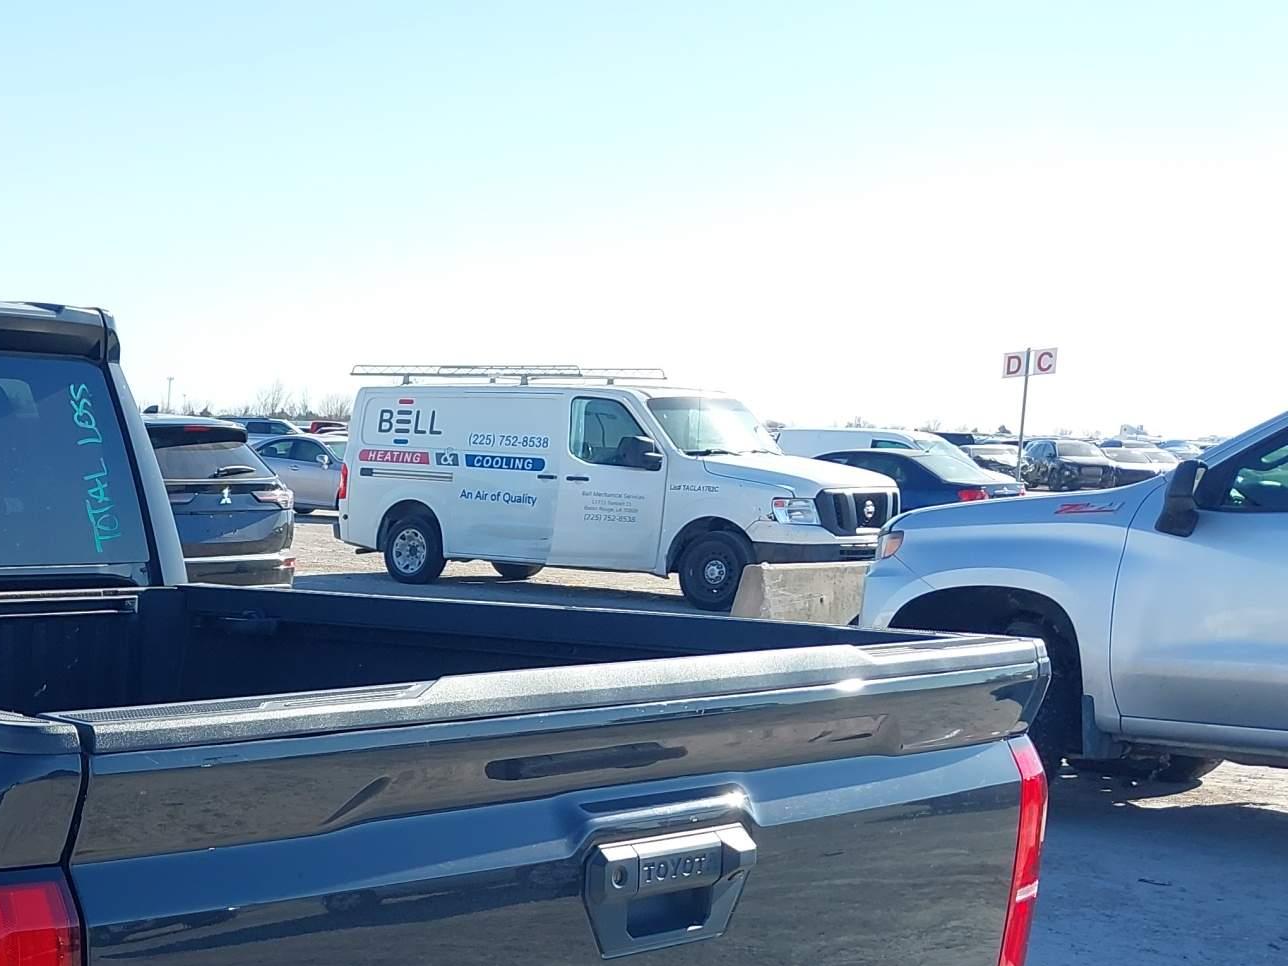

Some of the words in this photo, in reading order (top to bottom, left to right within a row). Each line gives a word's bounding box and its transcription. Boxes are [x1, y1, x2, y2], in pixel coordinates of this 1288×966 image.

[1006, 355, 1022, 376] D
[1036, 352, 1053, 373] C
[69, 383, 103, 446] LOSS
[377, 409, 443, 435] BELL
[468, 433, 496, 447] (225)
[498, 434, 549, 449] 752-8538
[367, 450, 421, 463] HEATING
[473, 456, 534, 470] COOLING
[83, 457, 121, 553] TOTAL
[459, 489, 474, 499] An
[475, 490, 489, 500] Air
[490, 491, 502, 501] of
[502, 492, 538, 507] Quality
[643, 851, 715, 883] TOYOT
